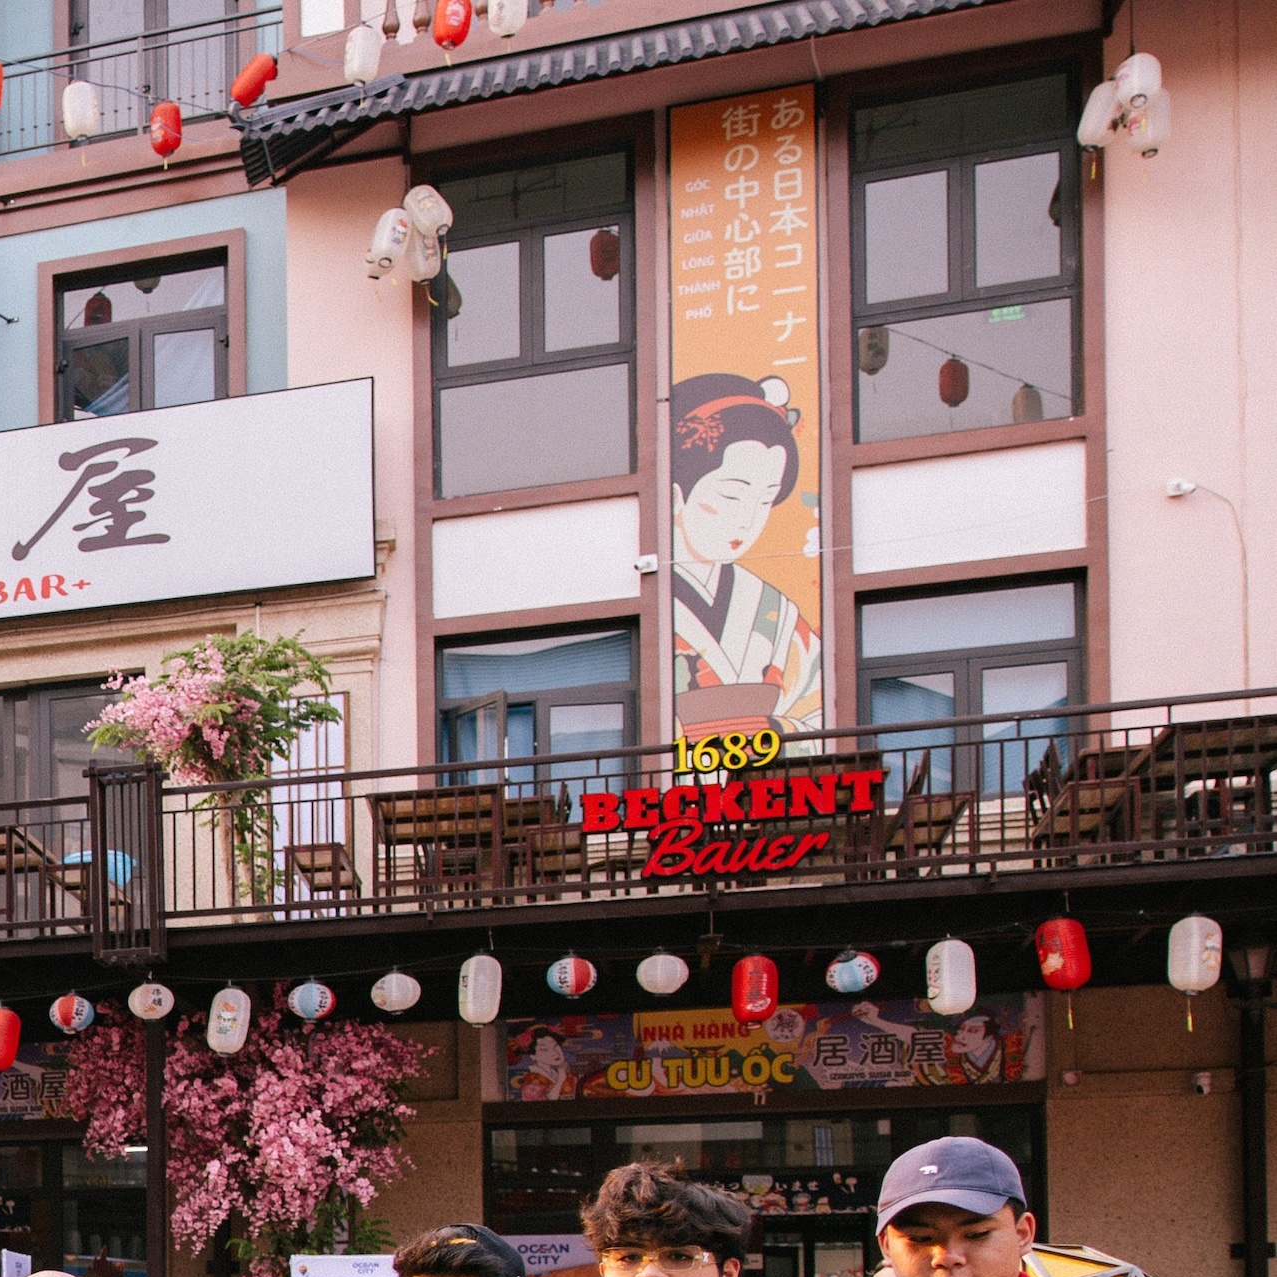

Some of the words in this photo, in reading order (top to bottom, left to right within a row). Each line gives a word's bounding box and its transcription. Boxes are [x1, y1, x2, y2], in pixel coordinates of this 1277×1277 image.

[721, 104, 761, 316] 街の中心部に
[769, 99, 808, 367] ある日本コーナー
[672, 729, 781, 774] 1689
[581, 770, 882, 834] BECKENT
[643, 815, 829, 878] Bauer
[816, 1030, 945, 1067] 居酒屋
[606, 1059, 653, 1091] CU
[518, 1244, 569, 1254] OCEAN
[528, 1255, 560, 1265] CITY
